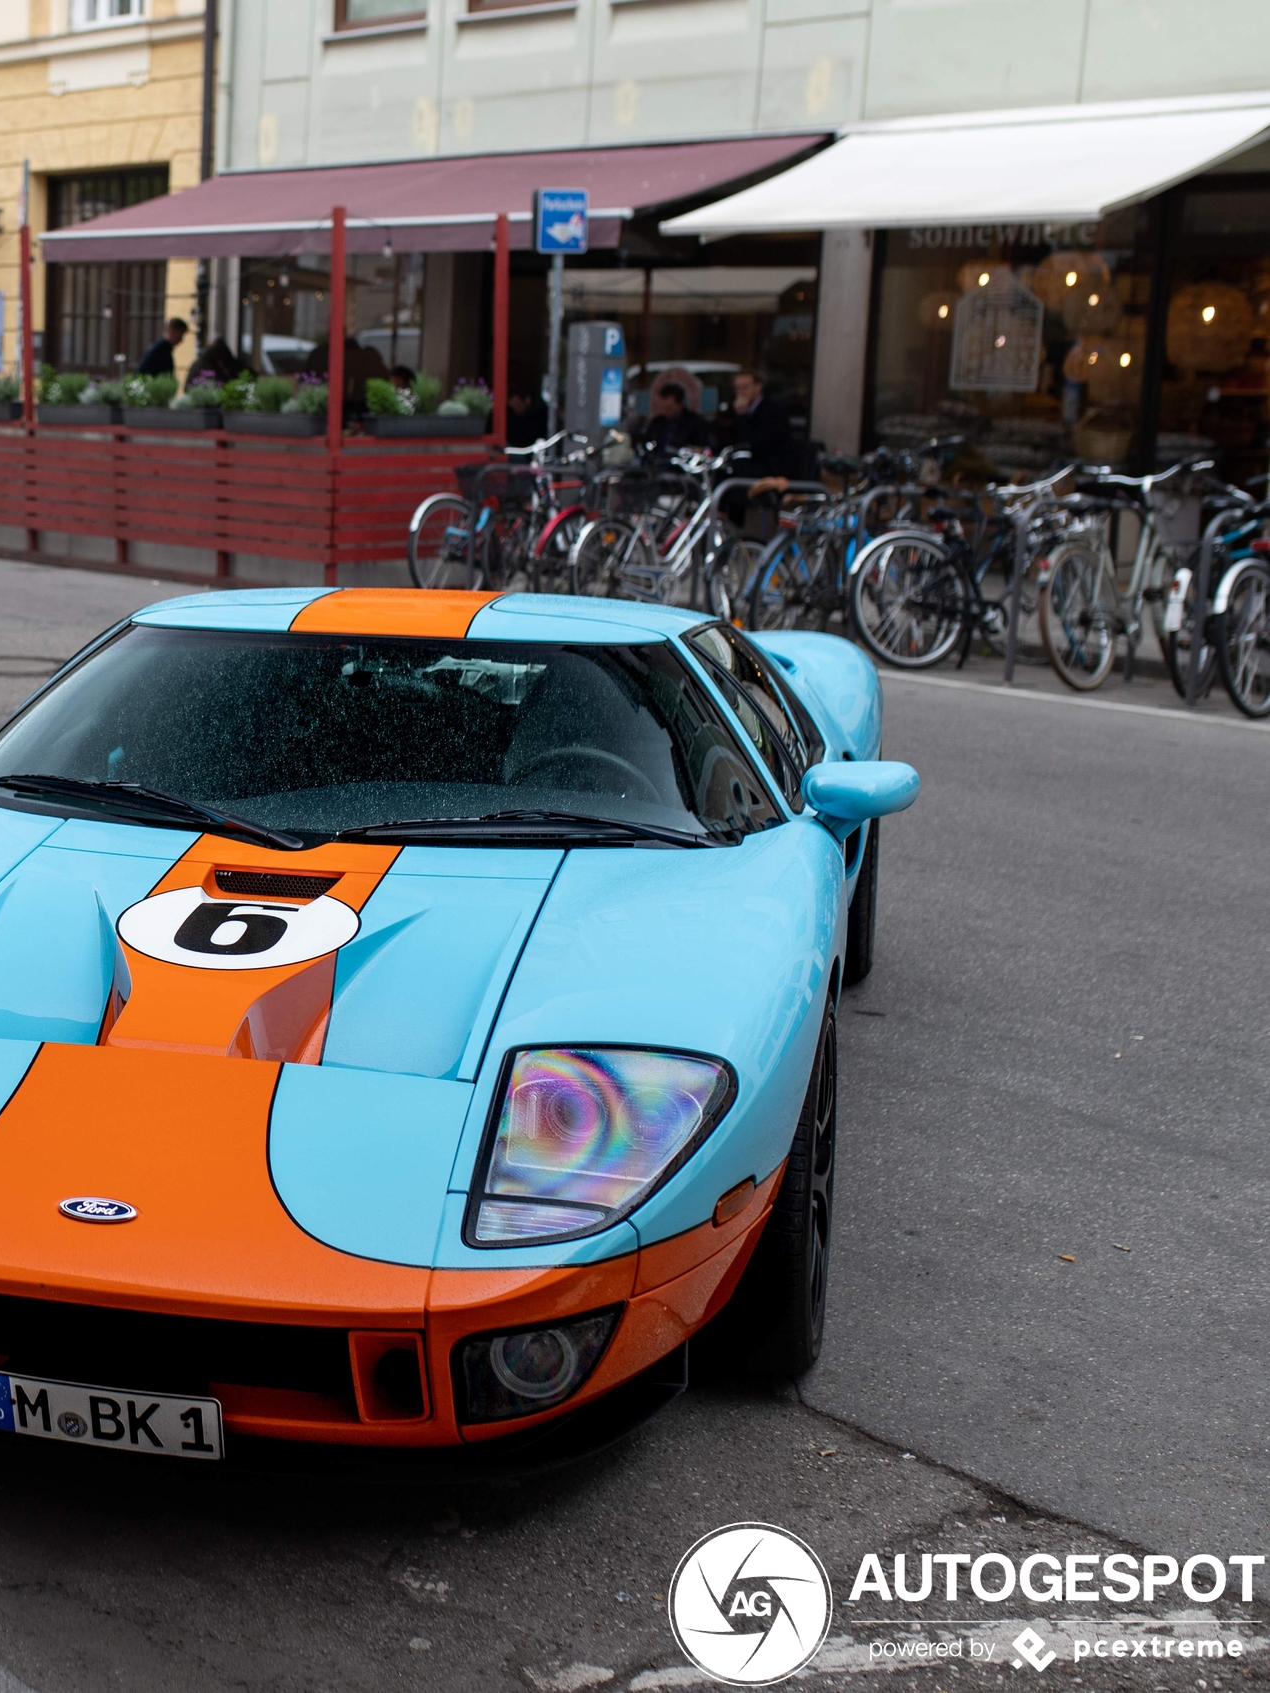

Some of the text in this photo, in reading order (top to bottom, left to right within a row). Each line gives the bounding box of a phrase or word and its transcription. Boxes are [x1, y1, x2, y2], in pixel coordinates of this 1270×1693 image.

[605, 326, 621, 355] P
[173, 902, 299, 956] 6
[76, 1200, 118, 1216] Ford
[14, 1384, 214, 1452] M BK 1
